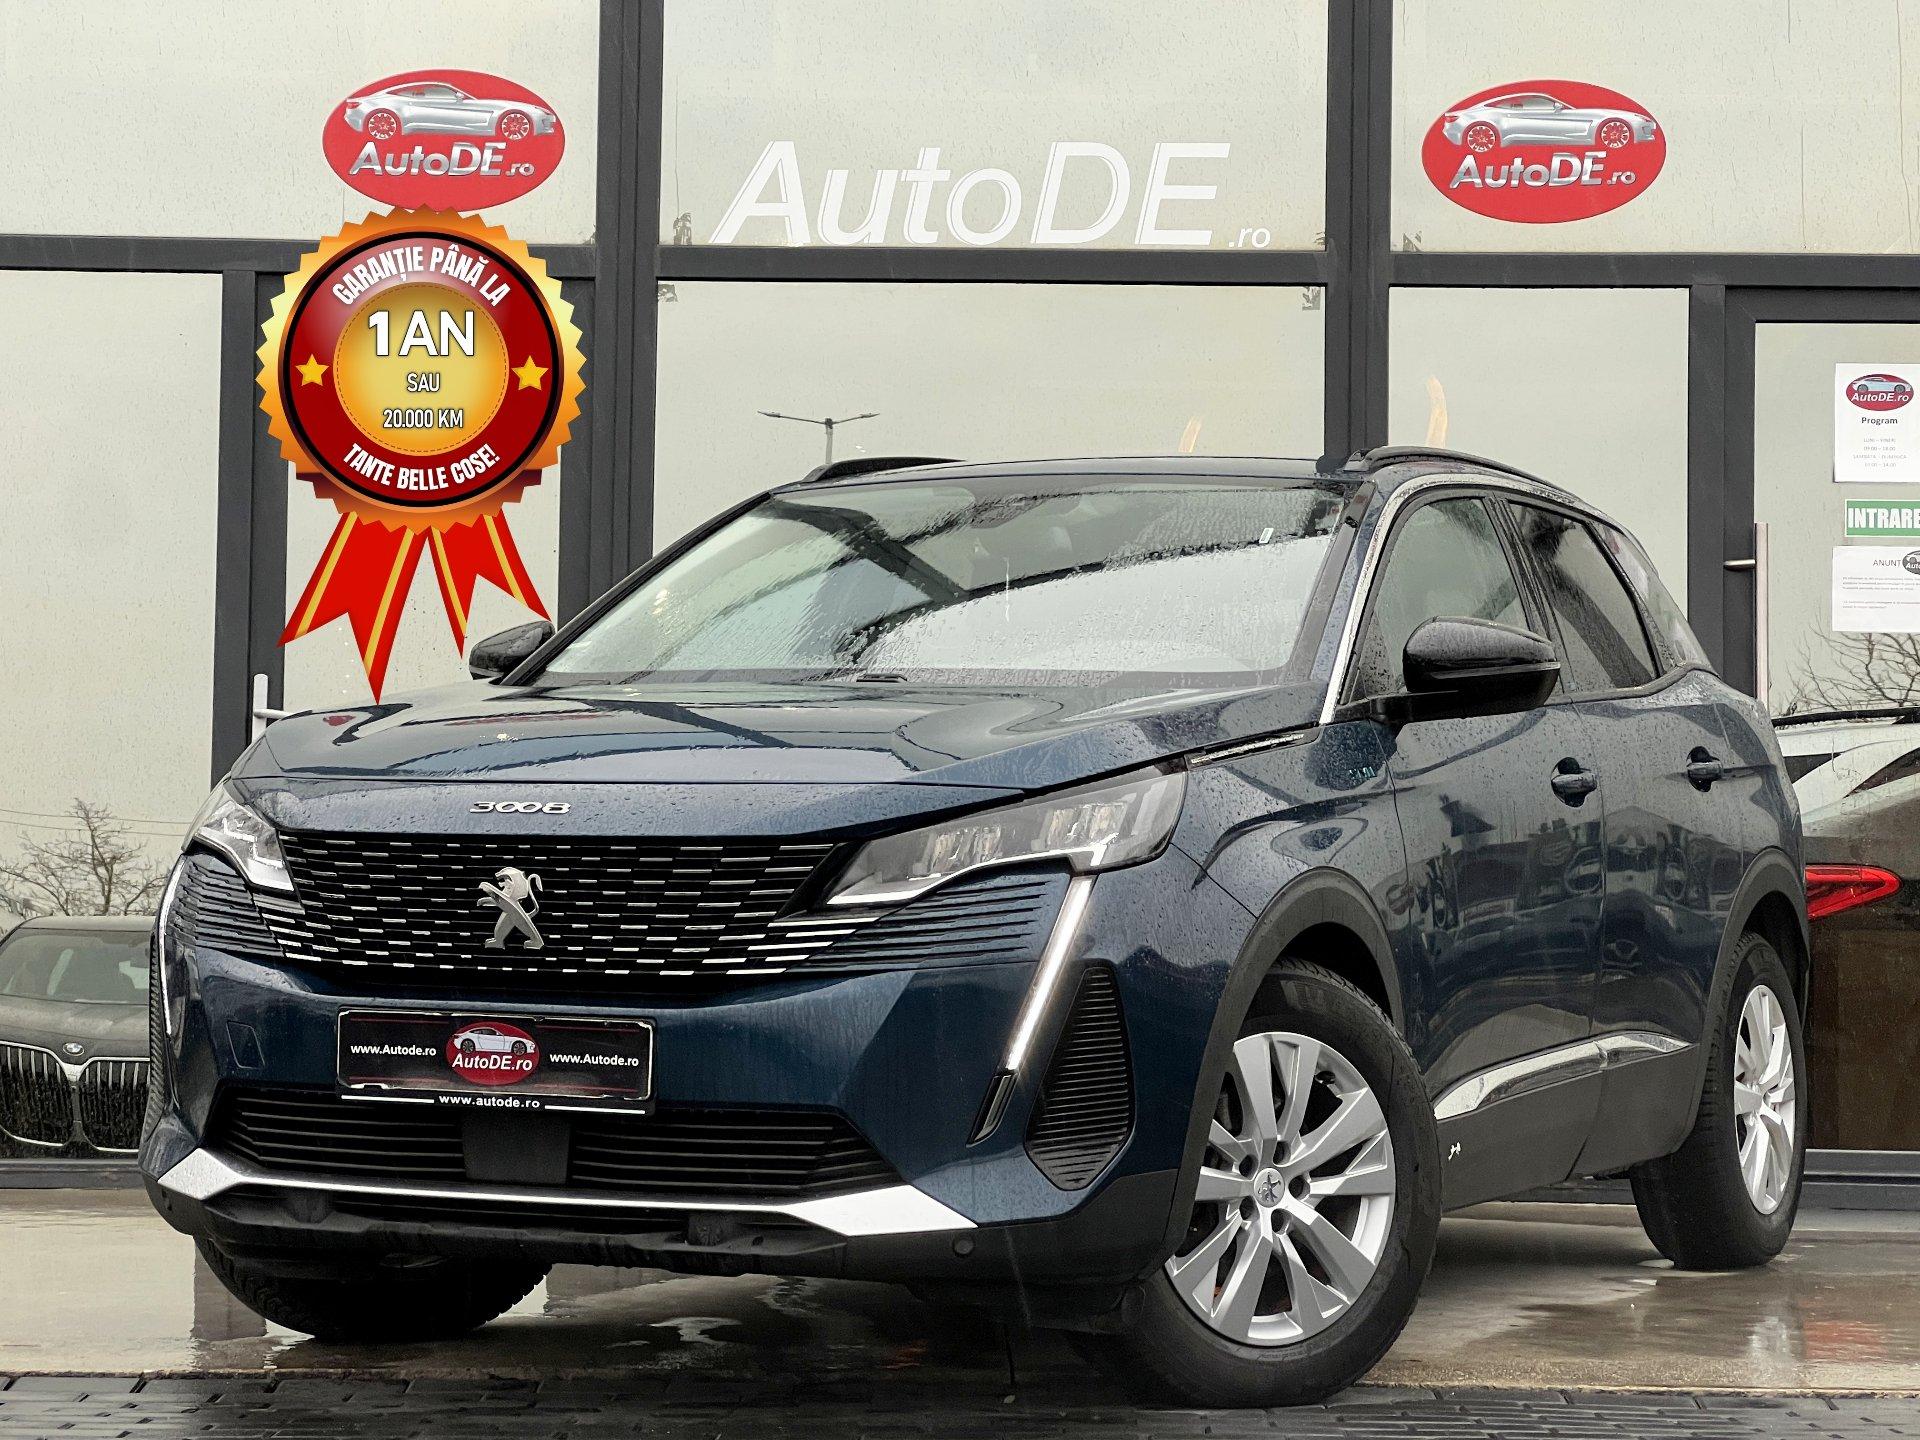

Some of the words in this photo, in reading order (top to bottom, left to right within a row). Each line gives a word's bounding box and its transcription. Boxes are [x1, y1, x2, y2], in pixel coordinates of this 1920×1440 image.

[1851, 392, 1909, 402] AutoDE.ro
[1861, 417, 1898, 425] Program
[1873, 559, 1901, 567] ANUNT
[469, 801, 572, 814] 3008
[350, 1044, 437, 1057] www.Autode.ro
[452, 1053, 533, 1071] AutoDE.ro
[549, 1052, 639, 1067] www.Autode.ro
[438, 1095, 540, 1109] www.autode.ro
